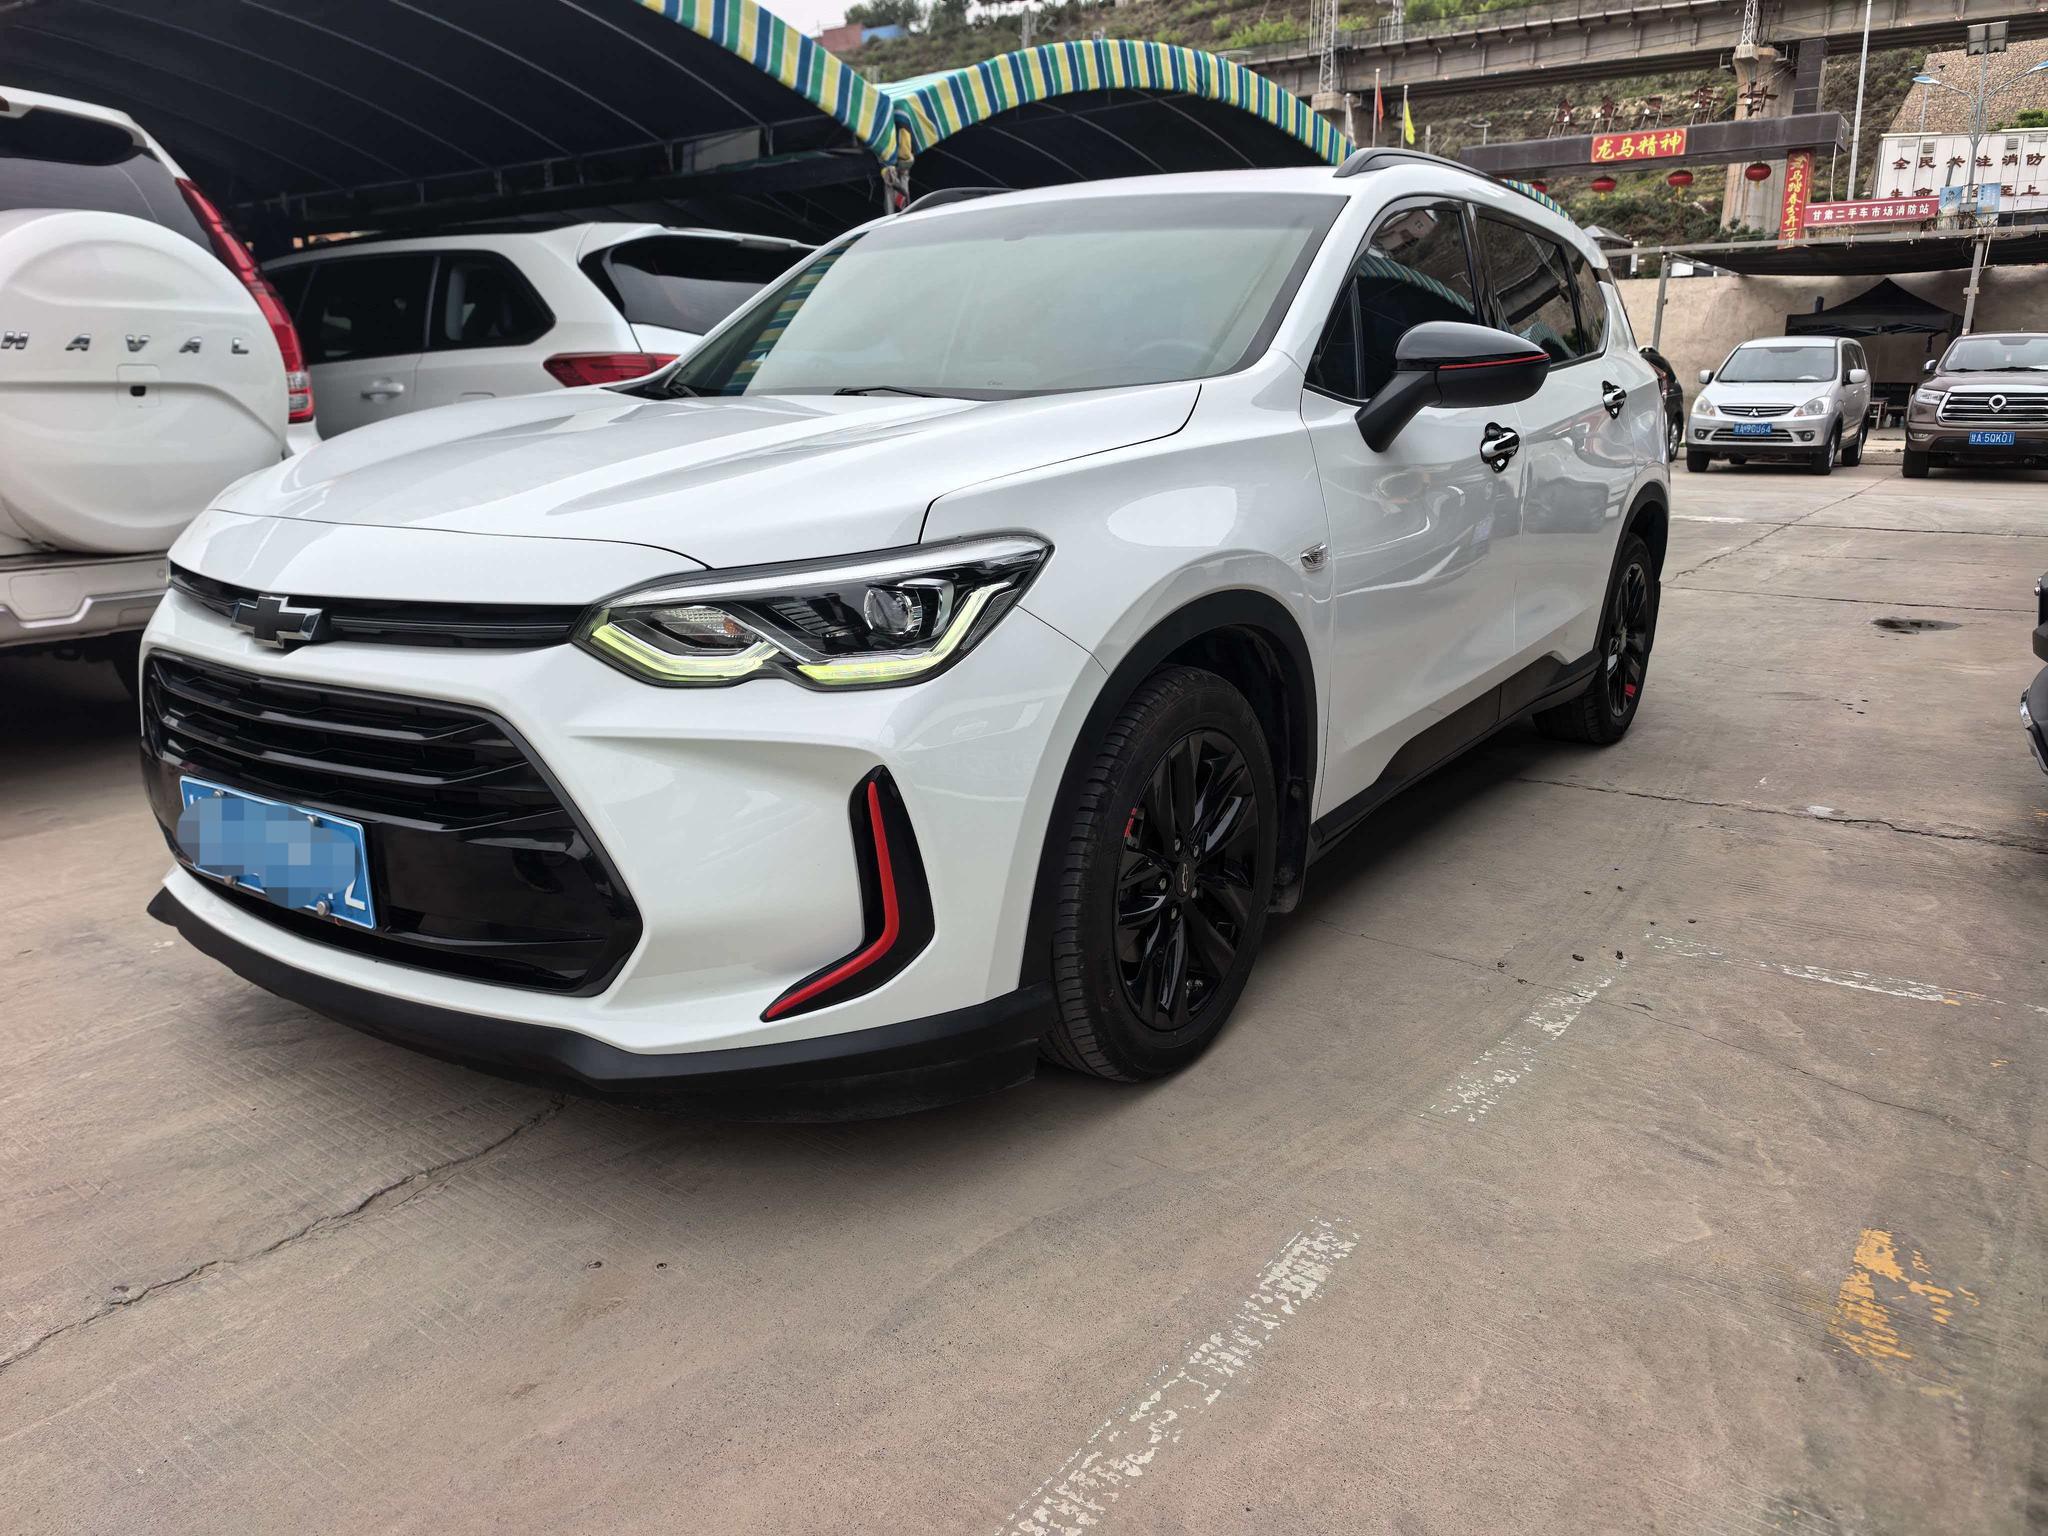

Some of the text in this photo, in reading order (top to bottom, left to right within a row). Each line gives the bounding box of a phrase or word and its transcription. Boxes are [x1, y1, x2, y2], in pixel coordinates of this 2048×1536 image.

[1596, 131, 1683, 160] 龙马精神
[1892, 153, 2045, 170] 全民关注消防
[1891, 185, 2040, 198] 生命至上
[1813, 203, 1929, 221] 甘肃二手车市场消防站
[1, 331, 249, 354] HAVAL
